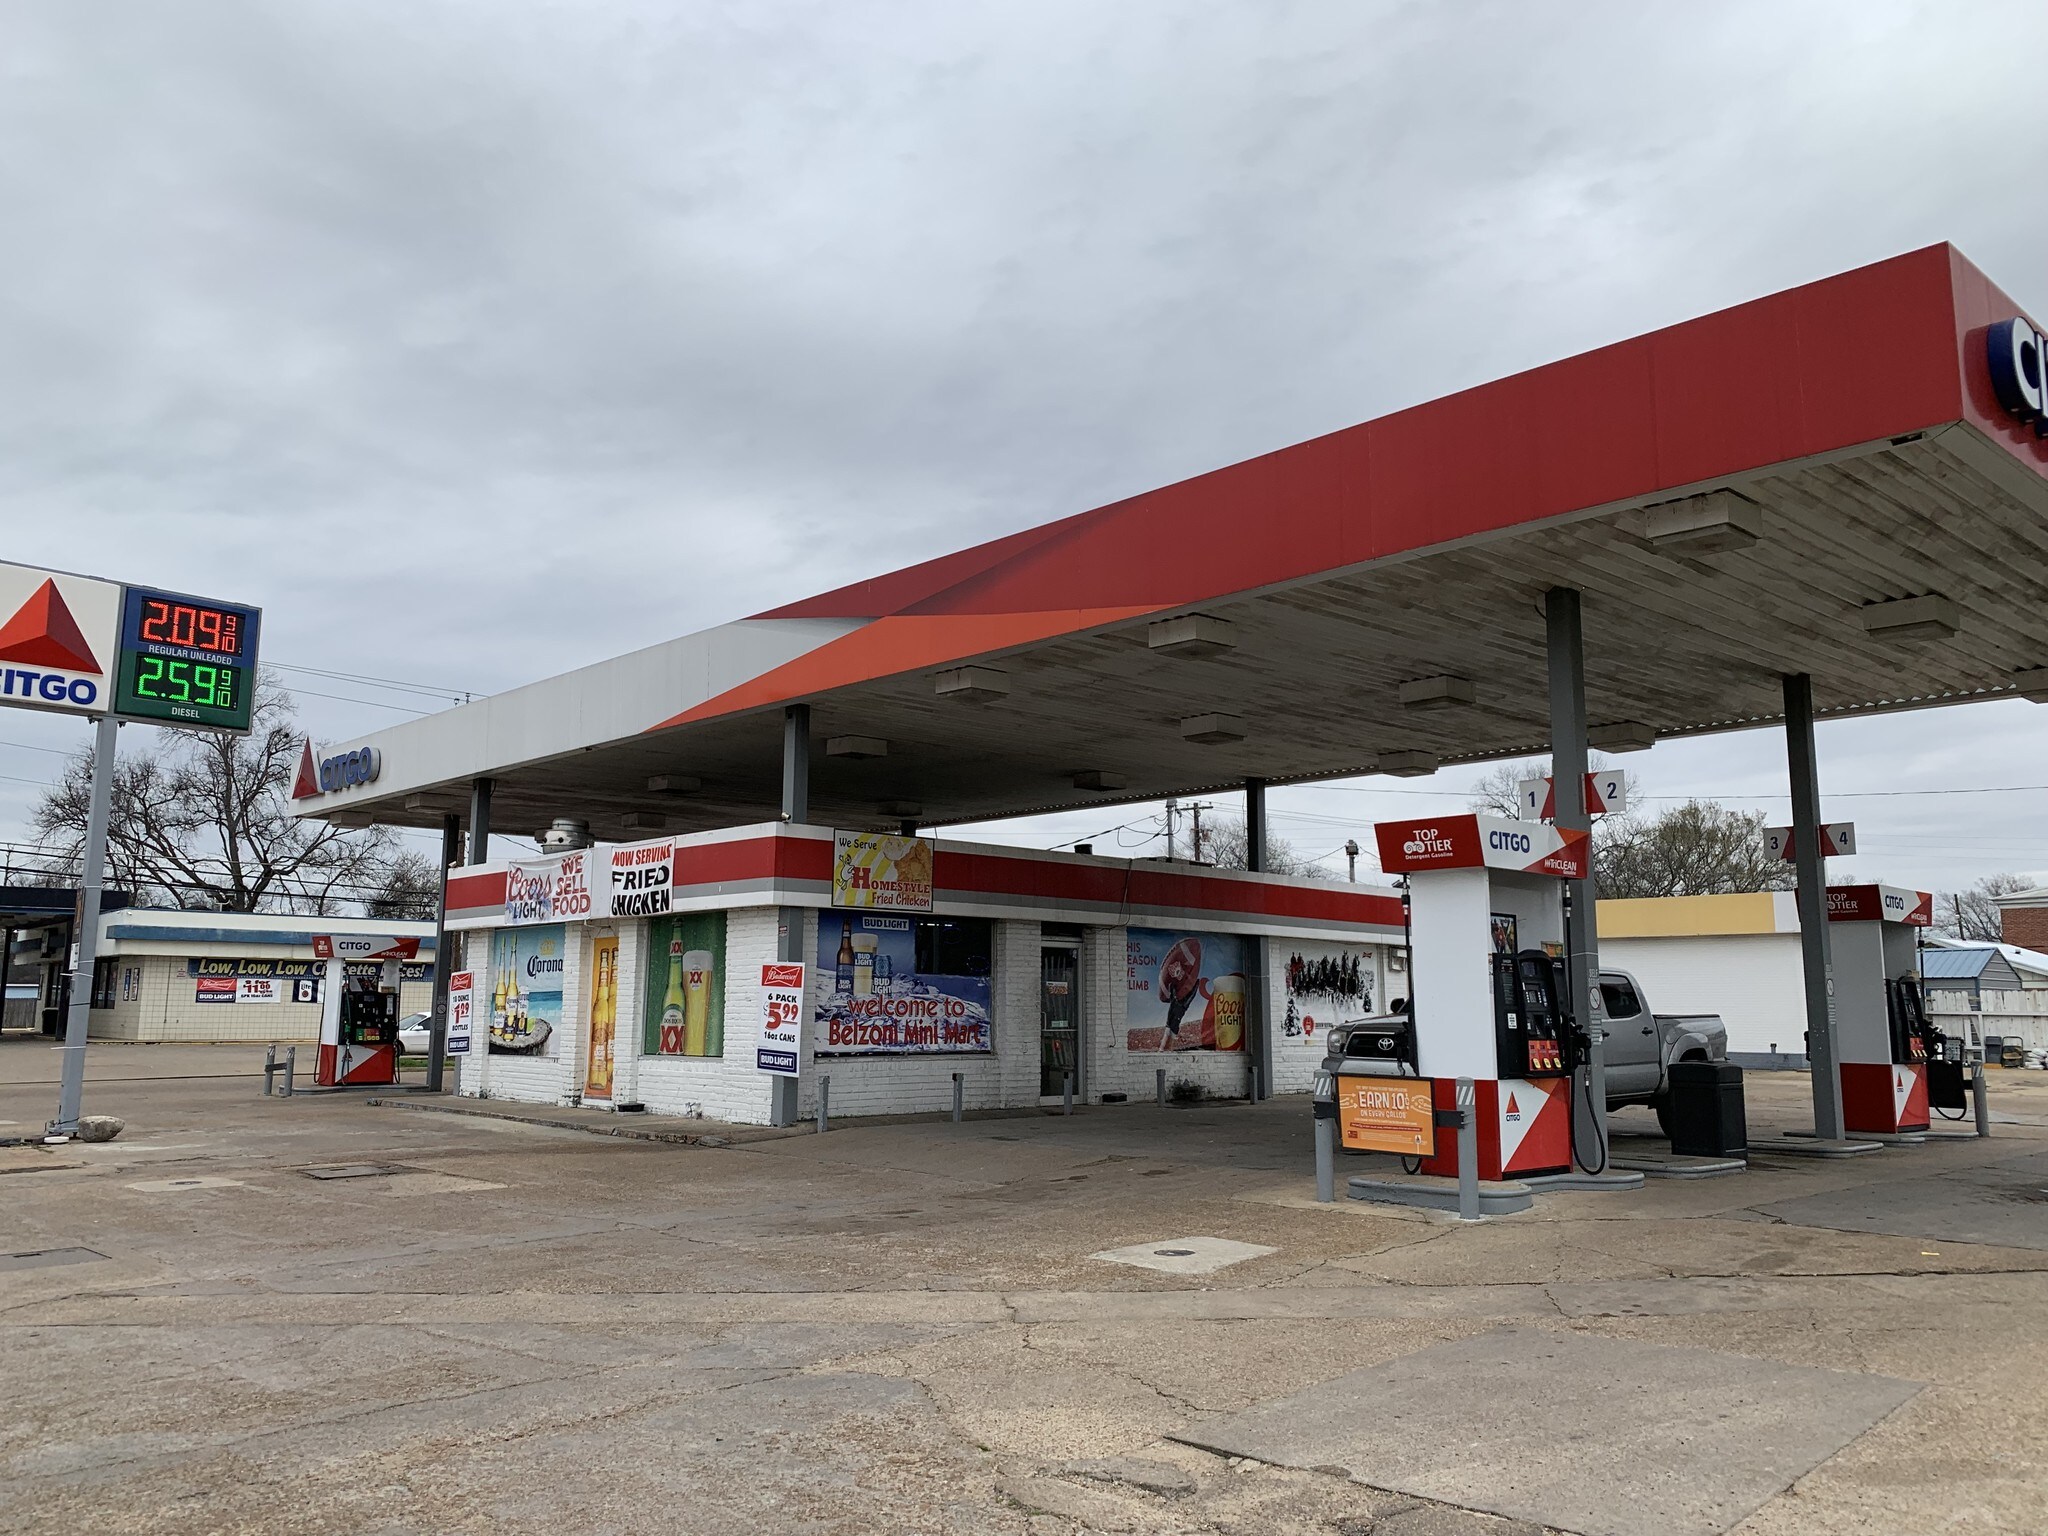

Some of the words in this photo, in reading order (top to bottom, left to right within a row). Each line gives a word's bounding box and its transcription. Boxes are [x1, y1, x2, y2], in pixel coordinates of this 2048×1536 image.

[143, 601, 222, 651] 2.09
[149, 644, 188, 658] REGULAR
[190, 650, 232, 665] UNLEADED
[0, 668, 97, 706] ITGO
[138, 657, 216, 705] 2.59
[171, 706, 200, 719] DIESEL
[321, 746, 372, 792] CITGO
[1607, 782, 1617, 800] 2
[1528, 791, 1536, 808] 1
[1413, 828, 1438, 841] TOP
[1489, 830, 1530, 853] CITGO
[1839, 831, 1848, 845] 4
[839, 837, 853, 848] We
[853, 838, 877, 850] Serve
[1770, 836, 1779, 850] 3
[561, 855, 583, 875] WE
[612, 851, 634, 867] NOW
[509, 867, 552, 902] Coors
[556, 874, 587, 896] SELL
[612, 865, 670, 890] FRIED
[611, 888, 670, 916] CHICKEN
[872, 892, 894, 905] Fried
[895, 893, 930, 907] Chicken
[1827, 893, 1847, 901] TOP
[1835, 900, 1858, 909] TIER
[1885, 894, 1904, 910] CITGO
[552, 894, 591, 917] FOOD
[864, 918, 882, 928] BUD
[884, 918, 908, 929] LIGHT
[339, 941, 371, 951] CITGO
[1126, 942, 1141, 953] HIS
[199, 959, 235, 976] Low,
[237, 960, 274, 977] Low,
[276, 960, 308, 975] Low
[527, 954, 564, 979] Corona
[1126, 955, 1157, 966] EASON
[689, 971, 702, 984] XX
[768, 970, 797, 981] Budweiser
[874, 977, 890, 986] BUD
[872, 985, 892, 994] LIGHT
[1126, 979, 1149, 991] LIMB
[767, 992, 774, 1001] 6
[775, 993, 797, 1003] PACK
[847, 994, 938, 1018] welcome
[944, 997, 965, 1018] to
[452, 1023, 469, 1031] BOTTLES
[829, 1018, 899, 1046] Belzoni
[904, 1019, 939, 1046] Mini
[944, 1019, 981, 1046] Mart
[660, 1025, 685, 1053] XX
[764, 1031, 778, 1041] 16oz
[779, 1032, 796, 1043] CANS
[761, 1054, 774, 1064] BUD
[774, 1055, 793, 1067] LIGHT
[1358, 1090, 1390, 1109] EARN
[1360, 1109, 1368, 1117] ON
[1368, 1110, 1385, 1118] EVERY
